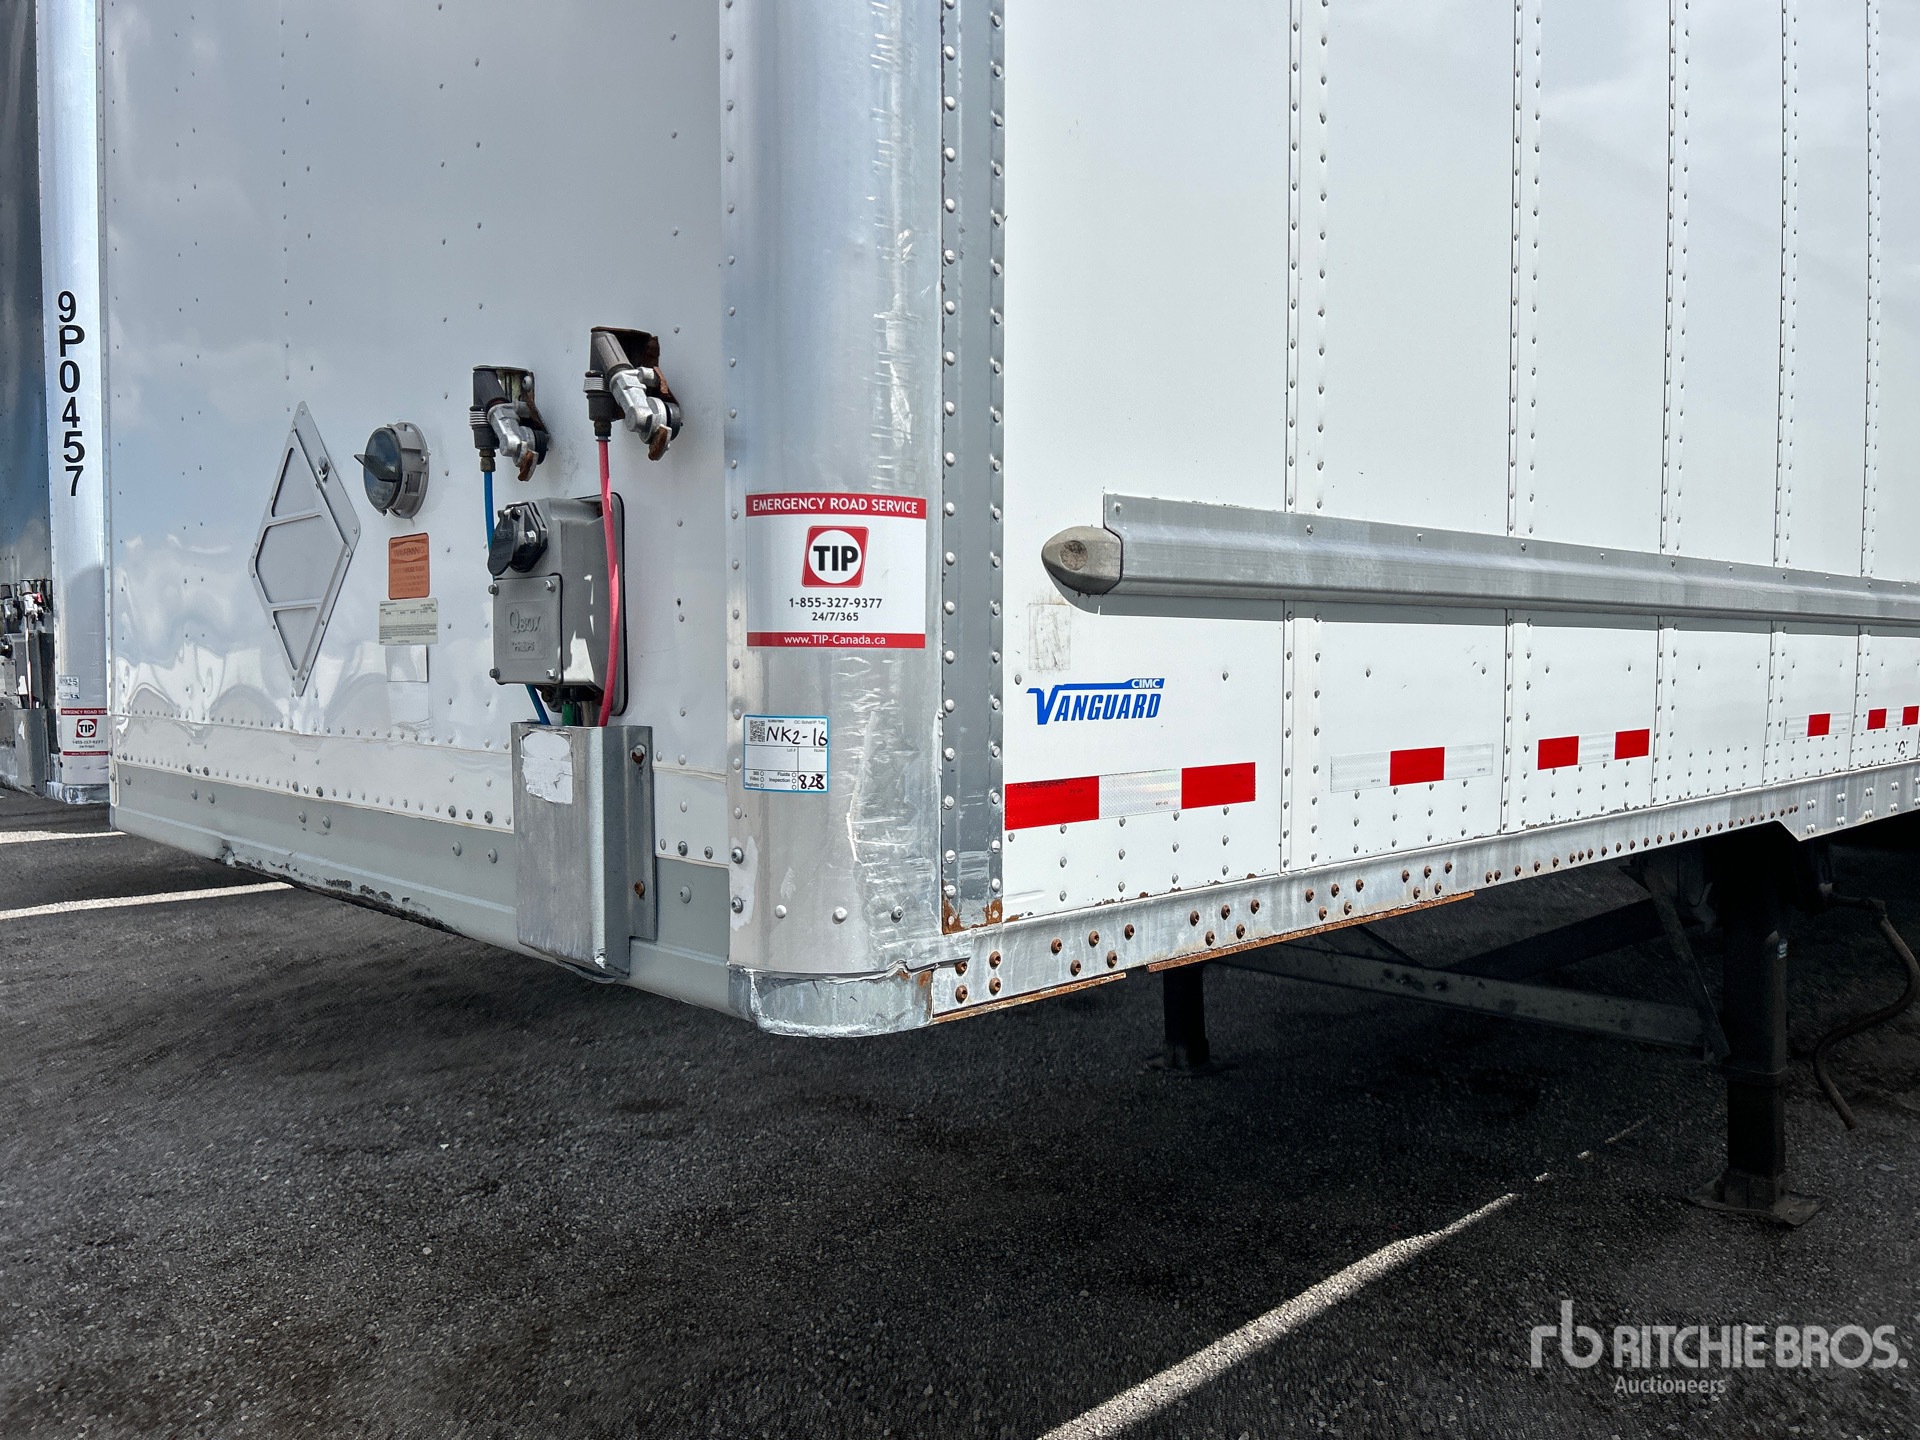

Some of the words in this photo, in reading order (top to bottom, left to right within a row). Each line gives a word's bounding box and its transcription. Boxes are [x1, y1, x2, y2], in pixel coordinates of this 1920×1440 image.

[57, 290, 86, 497] 9P0457
[753, 497, 826, 512] EMERGENCY
[829, 497, 868, 511] ROAD
[871, 498, 918, 515] SERVICE
[813, 545, 859, 572] TIP
[789, 597, 883, 609] 1-855-327-9377
[811, 611, 859, 622] 24/7/365
[784, 634, 886, 646] www.TIP-Canada.ca
[1131, 678, 1161, 689] CIMC
[1027, 685, 1162, 725] VANGUARD
[79, 724, 95, 733] TIP
[766, 726, 828, 747] NK2-16
